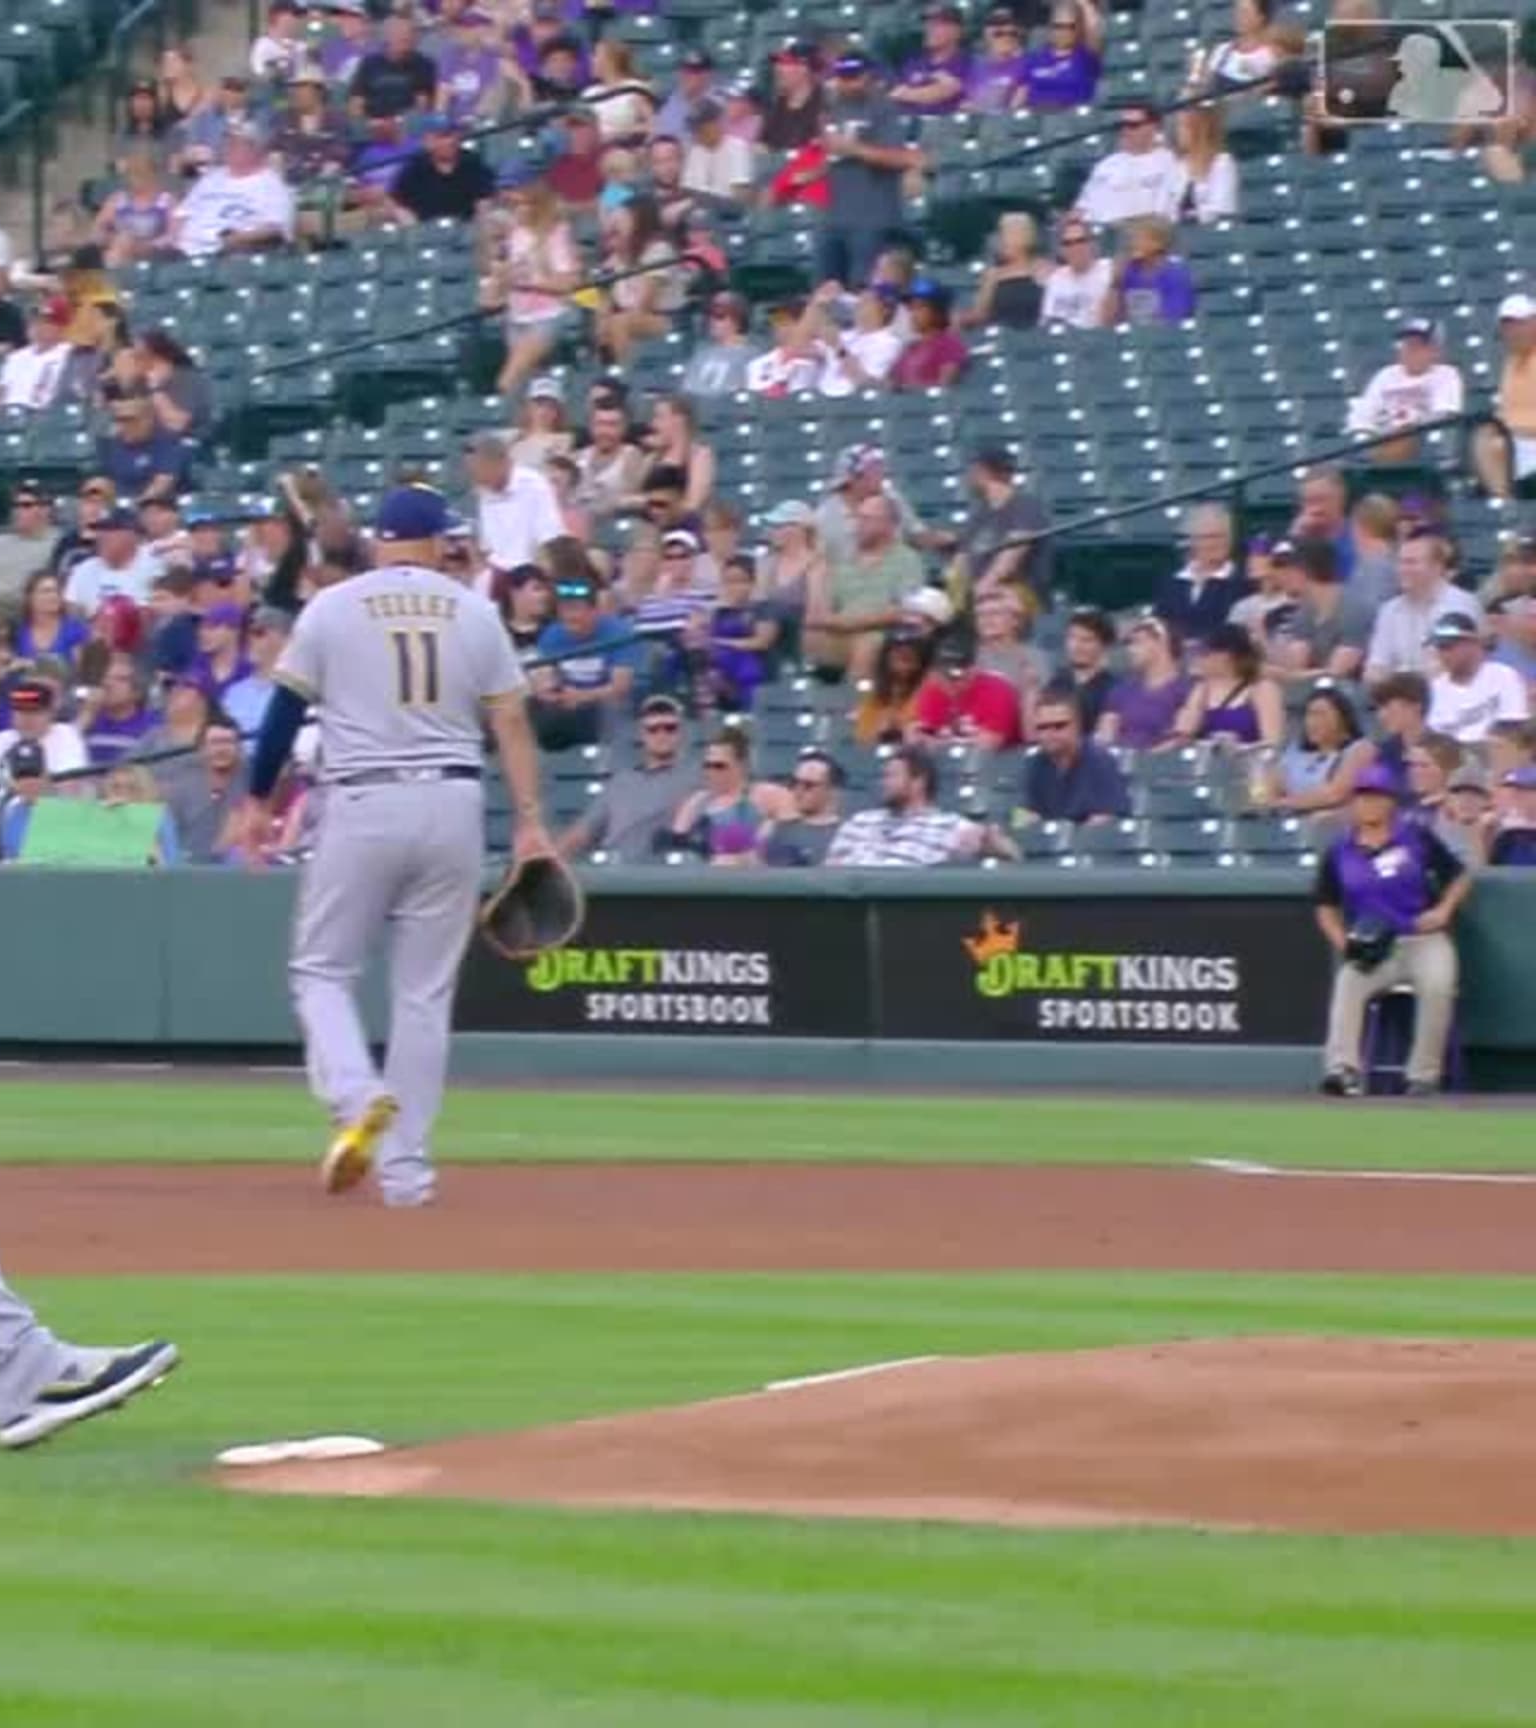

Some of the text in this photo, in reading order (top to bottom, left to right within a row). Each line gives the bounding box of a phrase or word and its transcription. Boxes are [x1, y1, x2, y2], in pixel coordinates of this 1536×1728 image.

[389, 629, 439, 704] 11
[527, 949, 769, 991] DRAFTKINGS
[975, 953, 1238, 996] DRAFTKINGS
[585, 994, 770, 1024] SPORTSBOOK
[1037, 999, 1240, 1031] SPORTSBOOK
